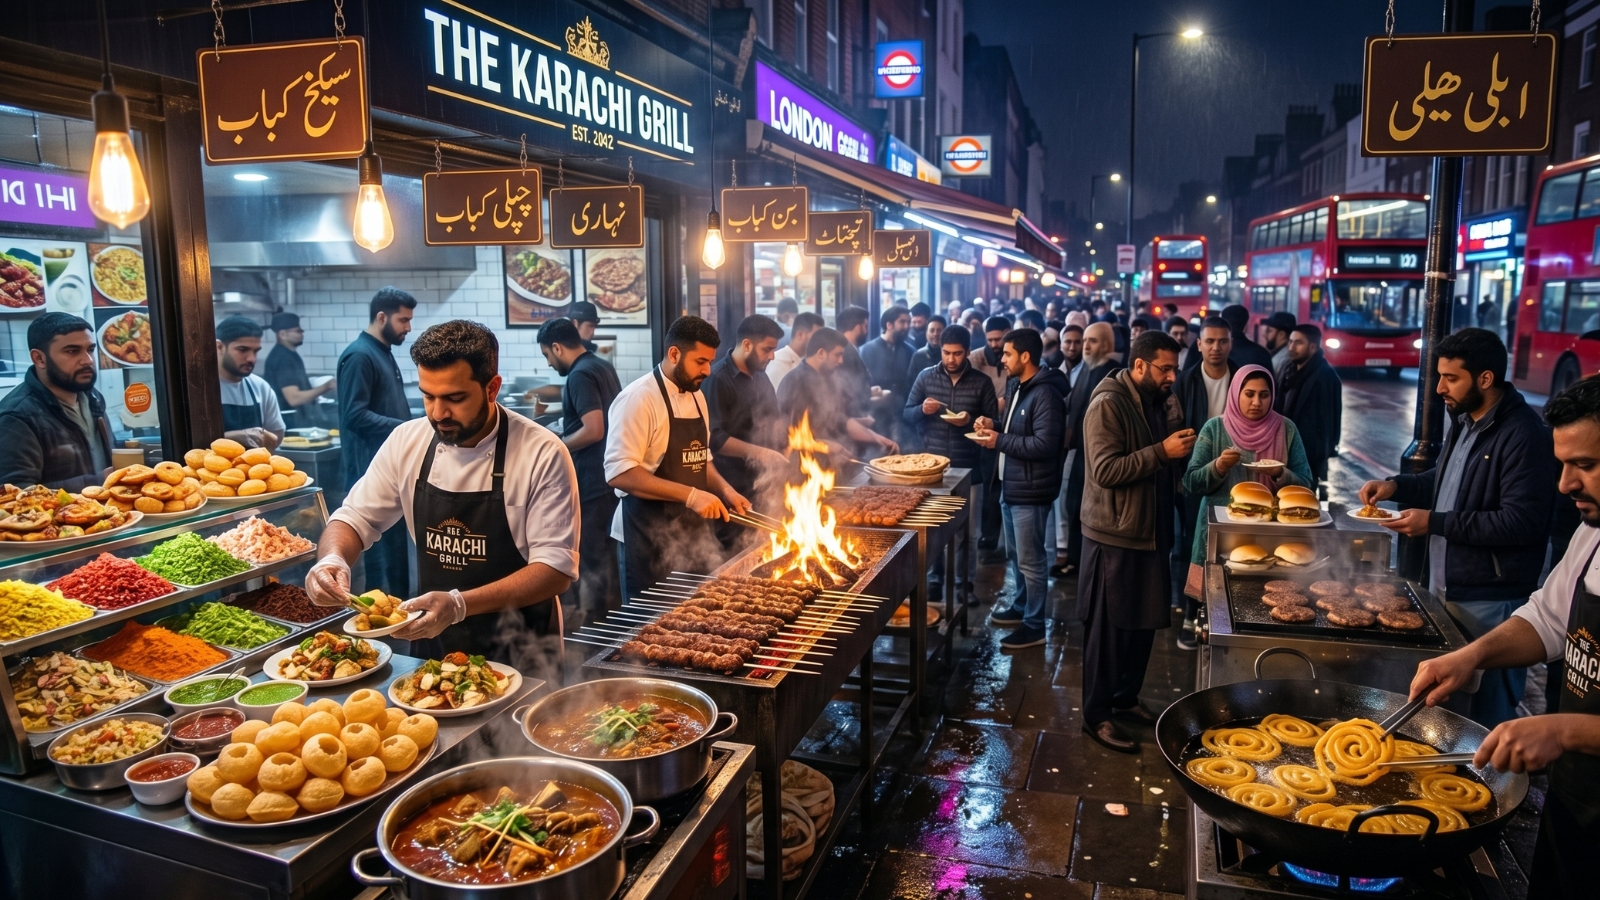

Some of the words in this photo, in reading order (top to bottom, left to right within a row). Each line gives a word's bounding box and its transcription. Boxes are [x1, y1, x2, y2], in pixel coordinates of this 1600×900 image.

[424, 8, 501, 93] THE
[510, 42, 633, 135] KARACHI
[638, 94, 694, 154] GRILL
[217, 74, 304, 145] کباب
[770, 89, 833, 152] LONDON
[572, 124, 591, 144] EST.
[593, 130, 614, 150] 2042
[435, 187, 498, 233] کباب
[571, 200, 627, 238] نہاری
[727, 198, 778, 234] کباب
[771, 202, 798, 231] بن
[426, 531, 487, 556] KARACHI
[439, 553, 469, 566] GRILL
